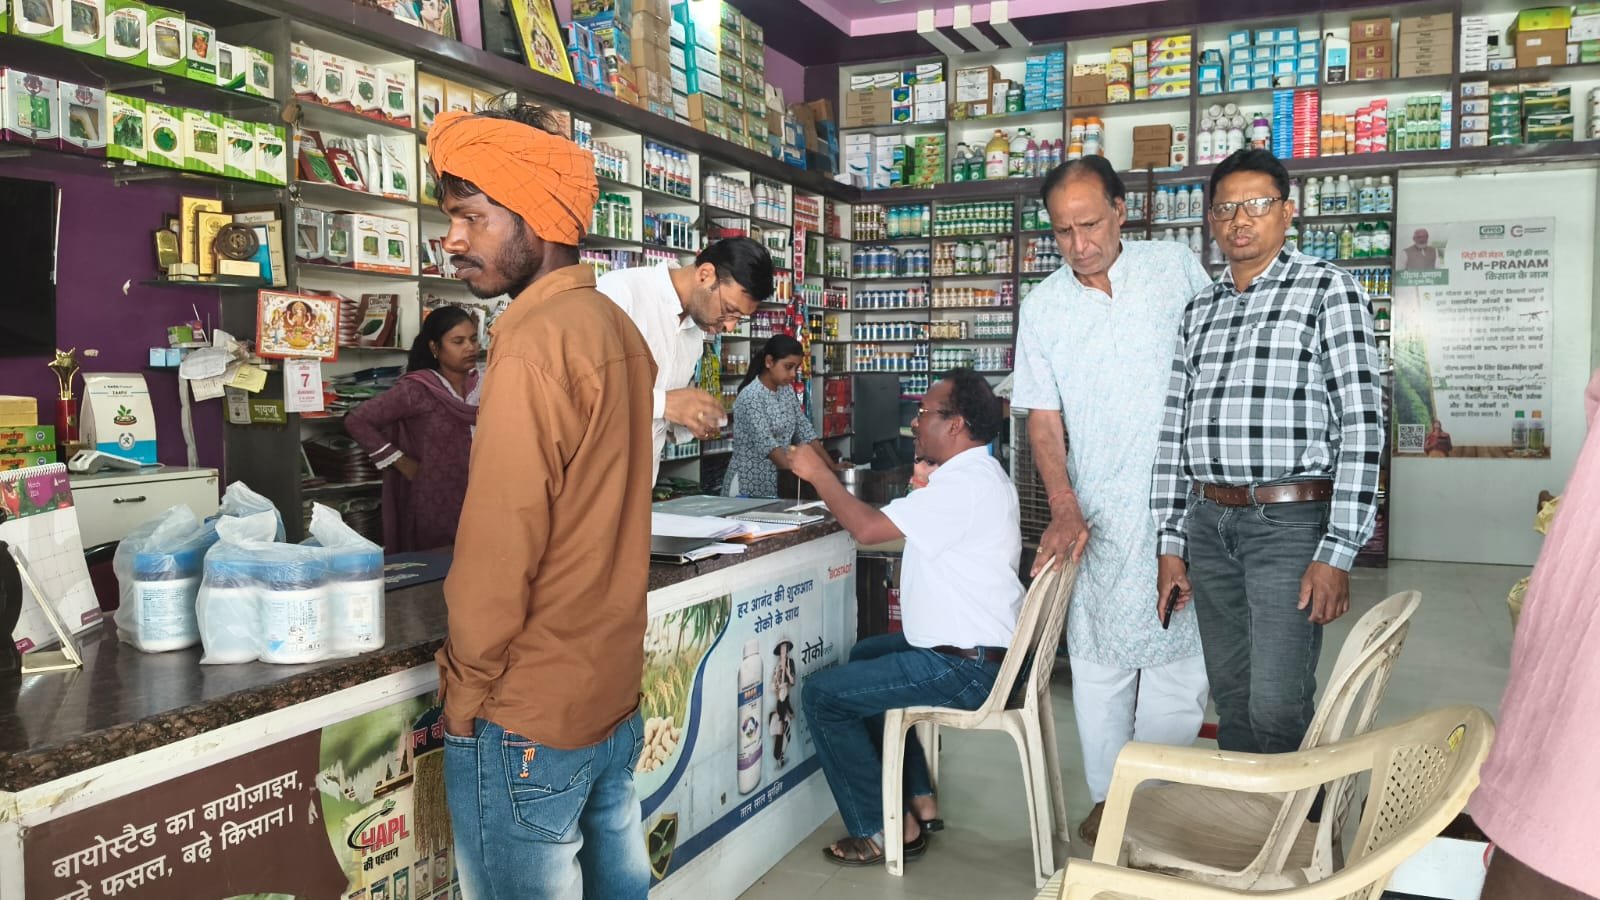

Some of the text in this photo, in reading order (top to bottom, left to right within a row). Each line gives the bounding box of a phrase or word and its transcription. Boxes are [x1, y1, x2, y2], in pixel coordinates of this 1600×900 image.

[1463, 258, 1549, 271] PM-PRANAM
[1518, 270, 1527, 279] के
[301, 374, 310, 387] 7
[737, 579, 814, 618] हर आनंद की शुरुआत
[754, 612, 773, 633] रोको
[775, 609, 783, 625] के
[801, 636, 824, 665] रोको
[52, 770, 303, 878] बायोस्टैड का बायोज़ाइम,
[361, 815, 410, 857] HAPL
[101, 855, 173, 897] फसल,
[181, 831, 213, 864] बढ़े
[219, 804, 294, 850] किसान।
[363, 847, 400, 872] की पहचान
